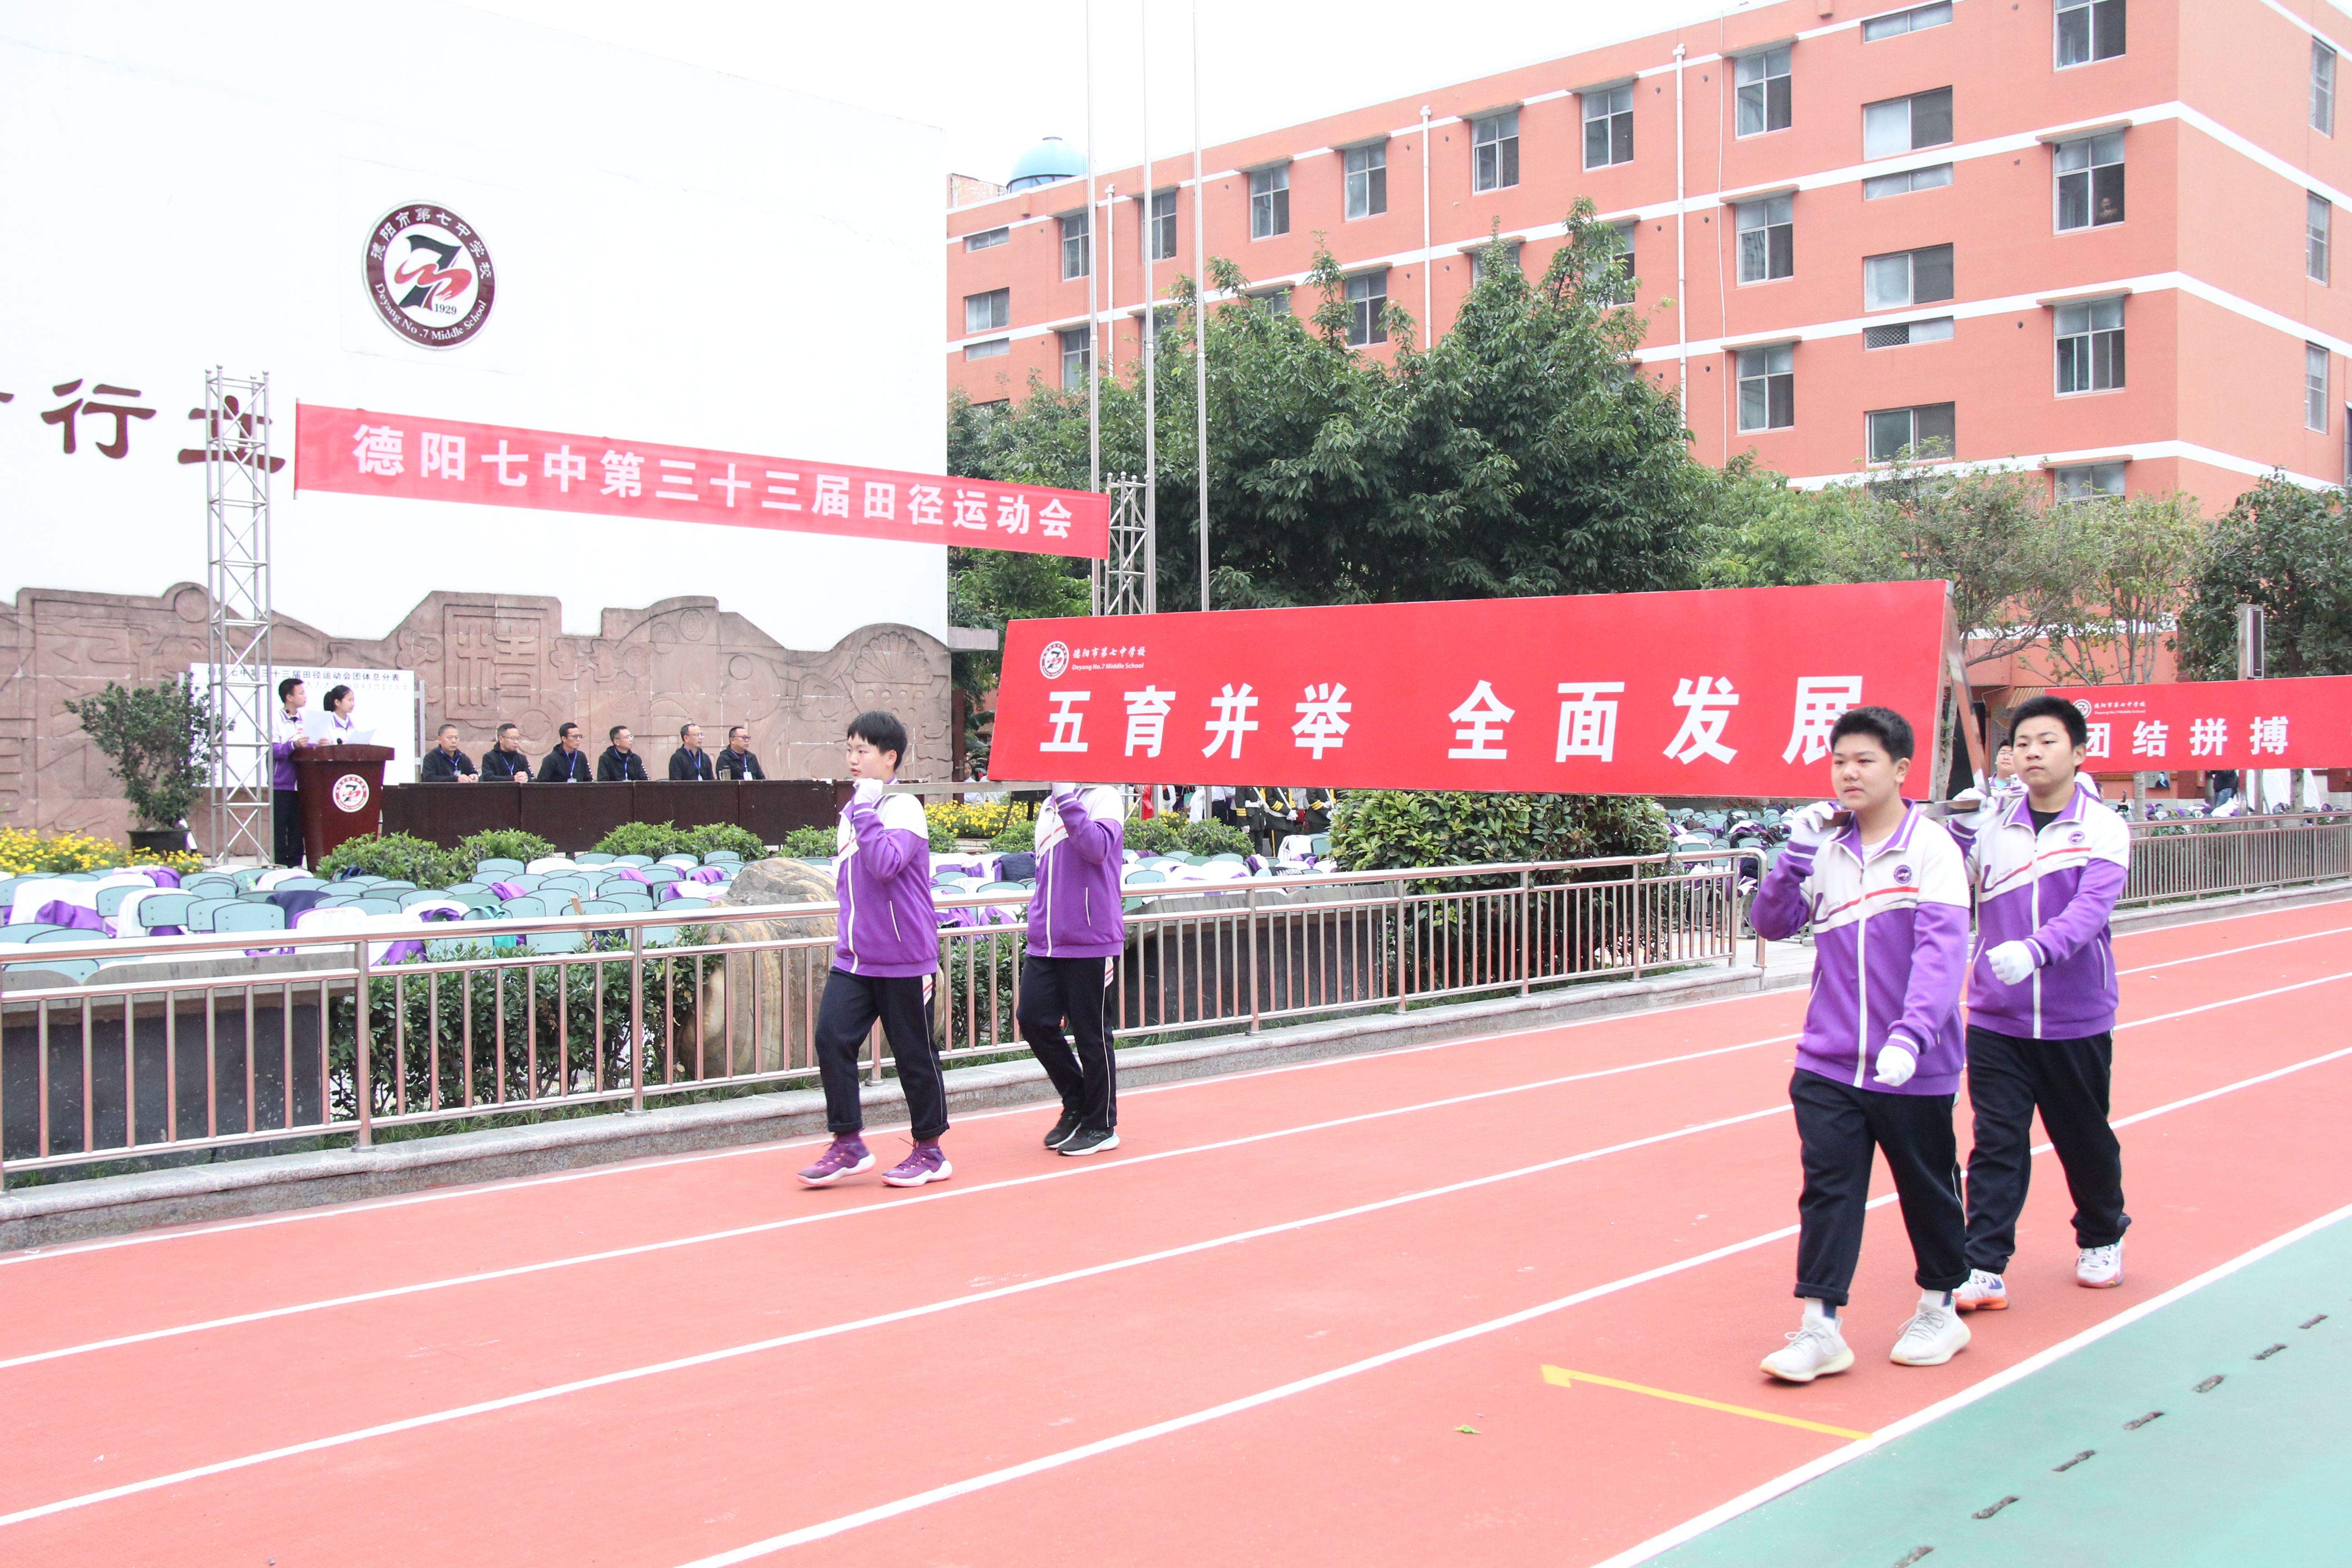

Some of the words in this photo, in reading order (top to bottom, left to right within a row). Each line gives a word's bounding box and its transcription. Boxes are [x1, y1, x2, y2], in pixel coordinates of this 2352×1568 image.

[375, 282, 402, 323] Deyang
[431, 326, 464, 340] Middle
[463, 299, 487, 330] School
[434, 303, 457, 315] 1929
[352, 423, 1072, 539] 德阳七中第三十三届田径运动会
[1072, 646, 1146, 659] 德阳市第七中学校
[1039, 682, 1352, 760] 五育并举
[1448, 675, 1863, 765] 全面发展
[2086, 716, 2289, 758] 团结拼搏
